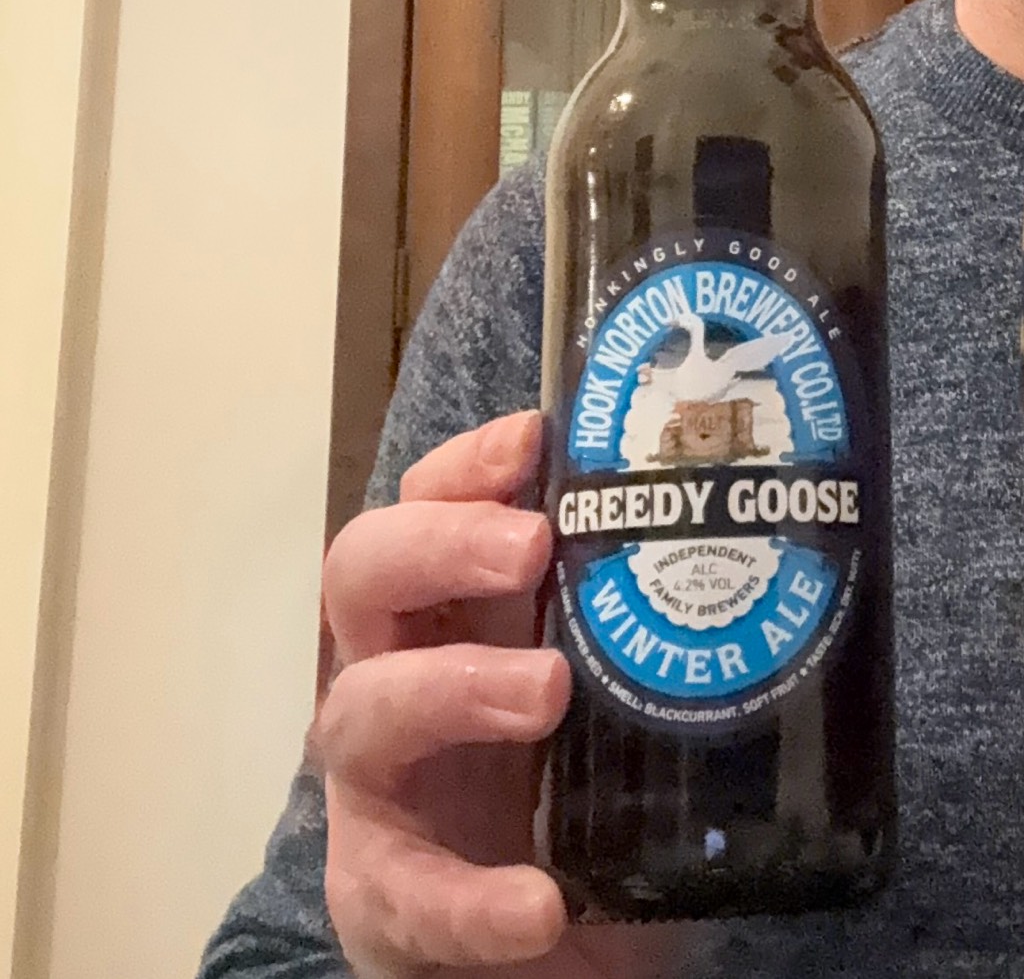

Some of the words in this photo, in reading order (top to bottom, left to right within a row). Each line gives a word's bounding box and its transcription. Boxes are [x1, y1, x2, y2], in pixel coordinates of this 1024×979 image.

[576, 238, 705, 348] HONKINGLY
[728, 240, 797, 282] GOOD
[807, 294, 841, 341] ALE
[695, 271, 821, 362] BREWERY
[593, 275, 692, 376] NORTON
[575, 371, 623, 449] HOOK
[558, 480, 715, 536] GREEDY
[727, 479, 859, 523] GOOSE
[653, 545, 757, 574] INDEPENDENT
[691, 563, 718, 576] ALC
[709, 578, 736, 591] VOL
[649, 578, 693, 614] FAMILY
[697, 575, 760, 617] BREWERS
[592, 578, 749, 684] WINTER
[761, 570, 824, 656] ALE
[742, 693, 770, 714] SOFT
[770, 673, 800, 699] FRUIT
